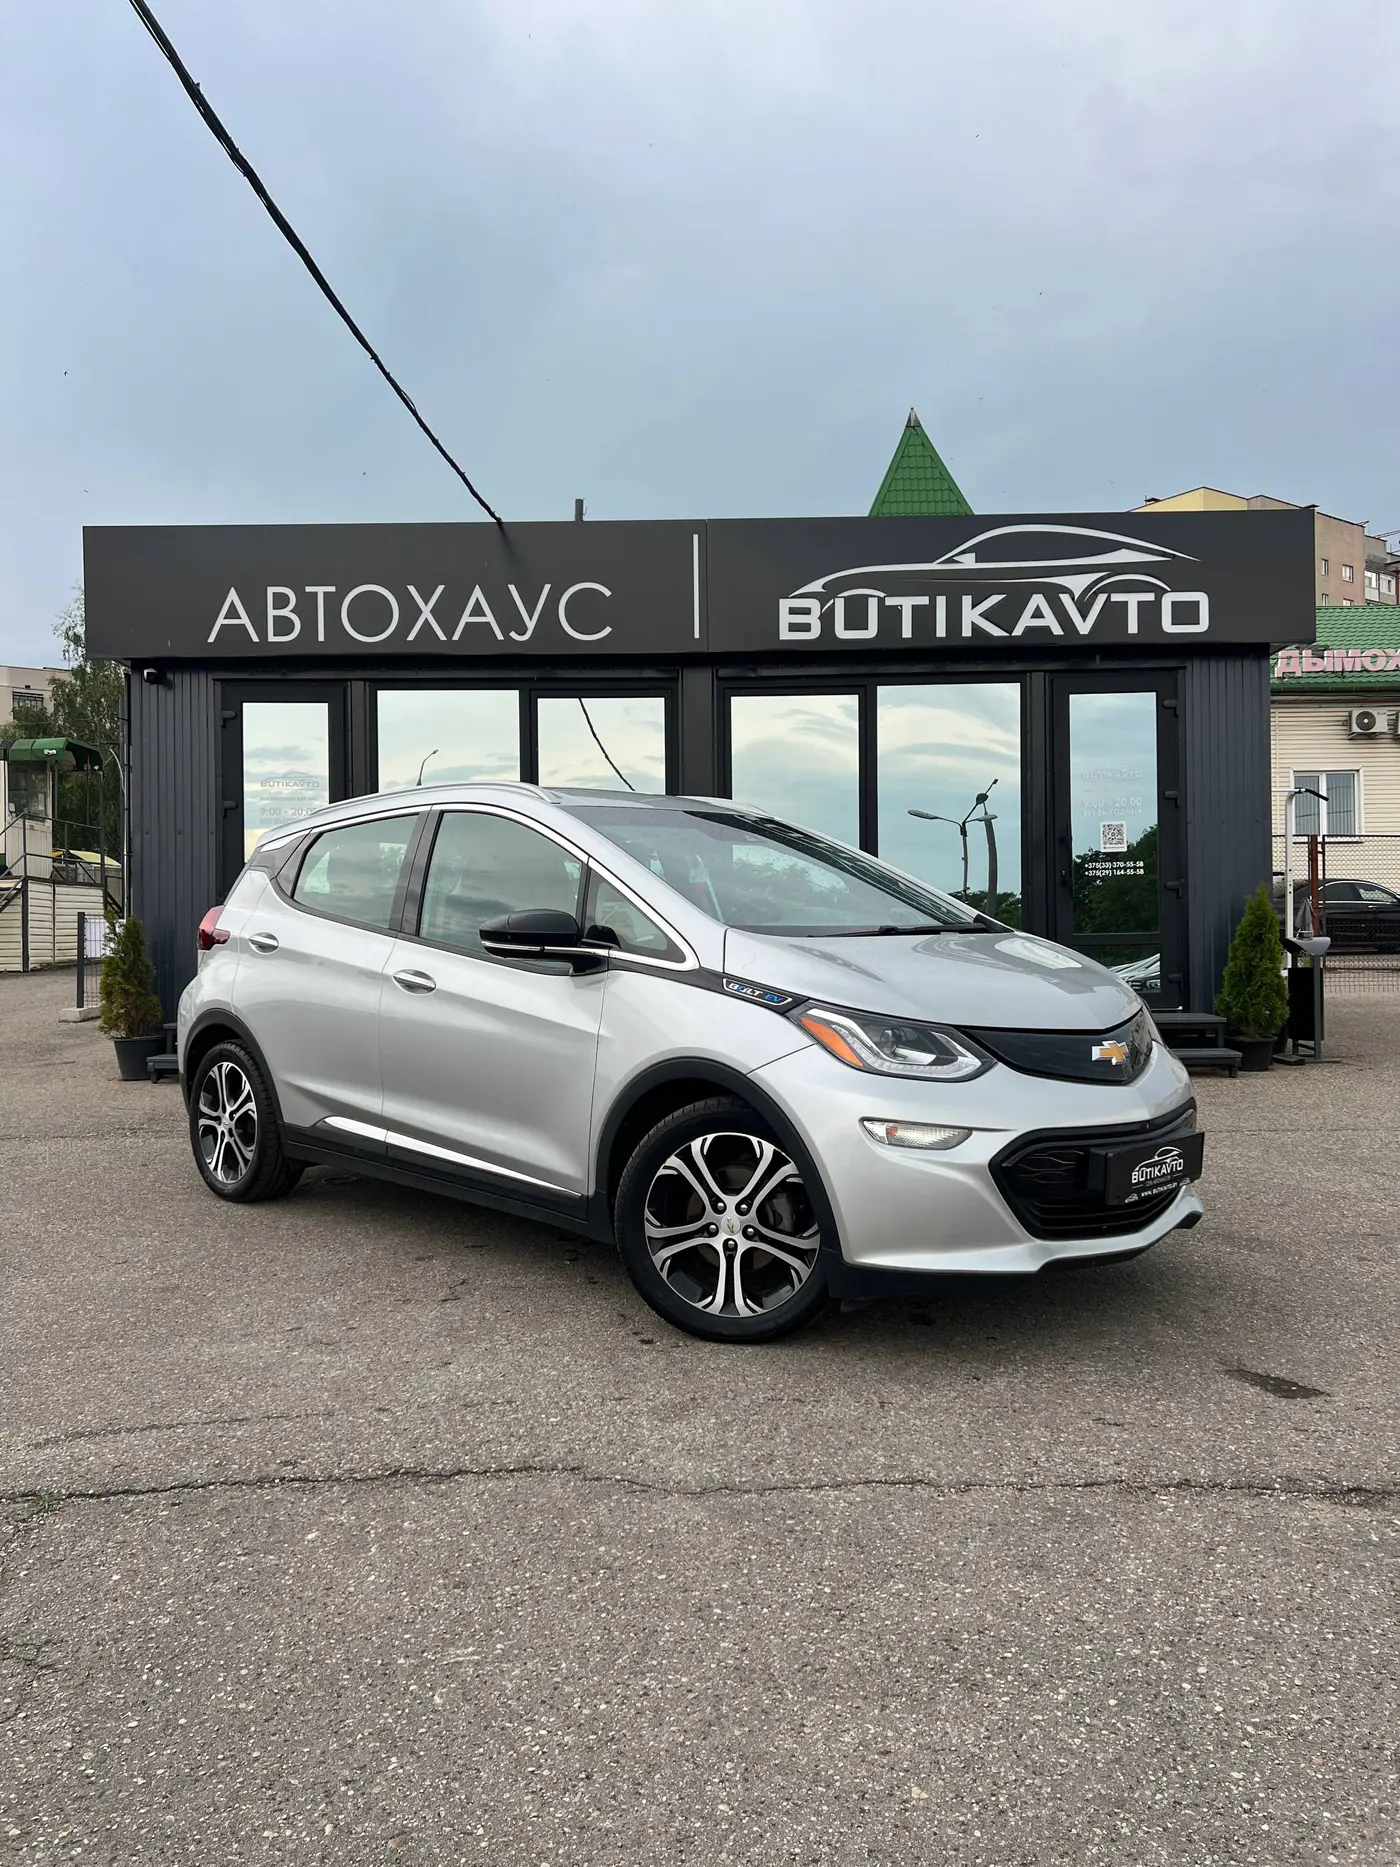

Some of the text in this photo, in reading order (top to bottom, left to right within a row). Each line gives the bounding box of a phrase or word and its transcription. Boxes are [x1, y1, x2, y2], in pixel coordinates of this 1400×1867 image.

[206, 581, 613, 643] АВТОХАУС
[778, 590, 1210, 641] BUTIKAVTO
[1275, 648, 1400, 678] ДЫМОХ
[260, 780, 320, 788] BUTIKAVTO
[291, 807, 317, 816] 20:0
[1084, 860, 1144, 870] +375(33) 370-55-58
[1084, 868, 1145, 878] +375(29) 164-55-58
[728, 983, 784, 1003] BOLT EV
[1131, 1159, 1184, 1184] BUTIKAVTO
